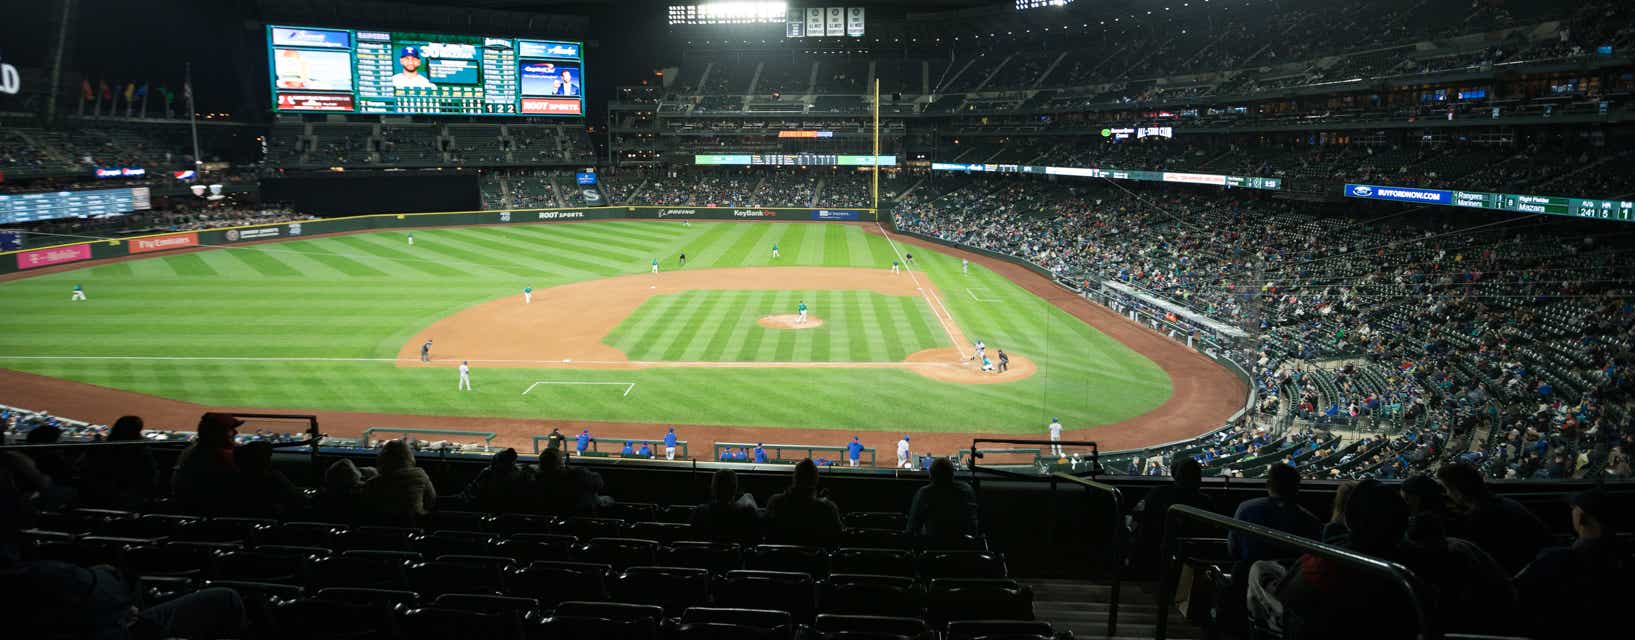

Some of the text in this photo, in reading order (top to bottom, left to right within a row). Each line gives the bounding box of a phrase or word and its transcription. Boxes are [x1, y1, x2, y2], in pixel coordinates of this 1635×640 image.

[497, 104, 504, 113] 2
[507, 104, 514, 113] 2
[1378, 189, 1441, 200] BUYFORDNOW.COM
[1458, 191, 1483, 200] Rangers
[1519, 203, 1545, 213] Mazara
[539, 211, 559, 219] ROOT
[734, 209, 764, 217] KeyBank
[1623, 208, 1628, 219] 1
[139, 239, 154, 249] Fly
